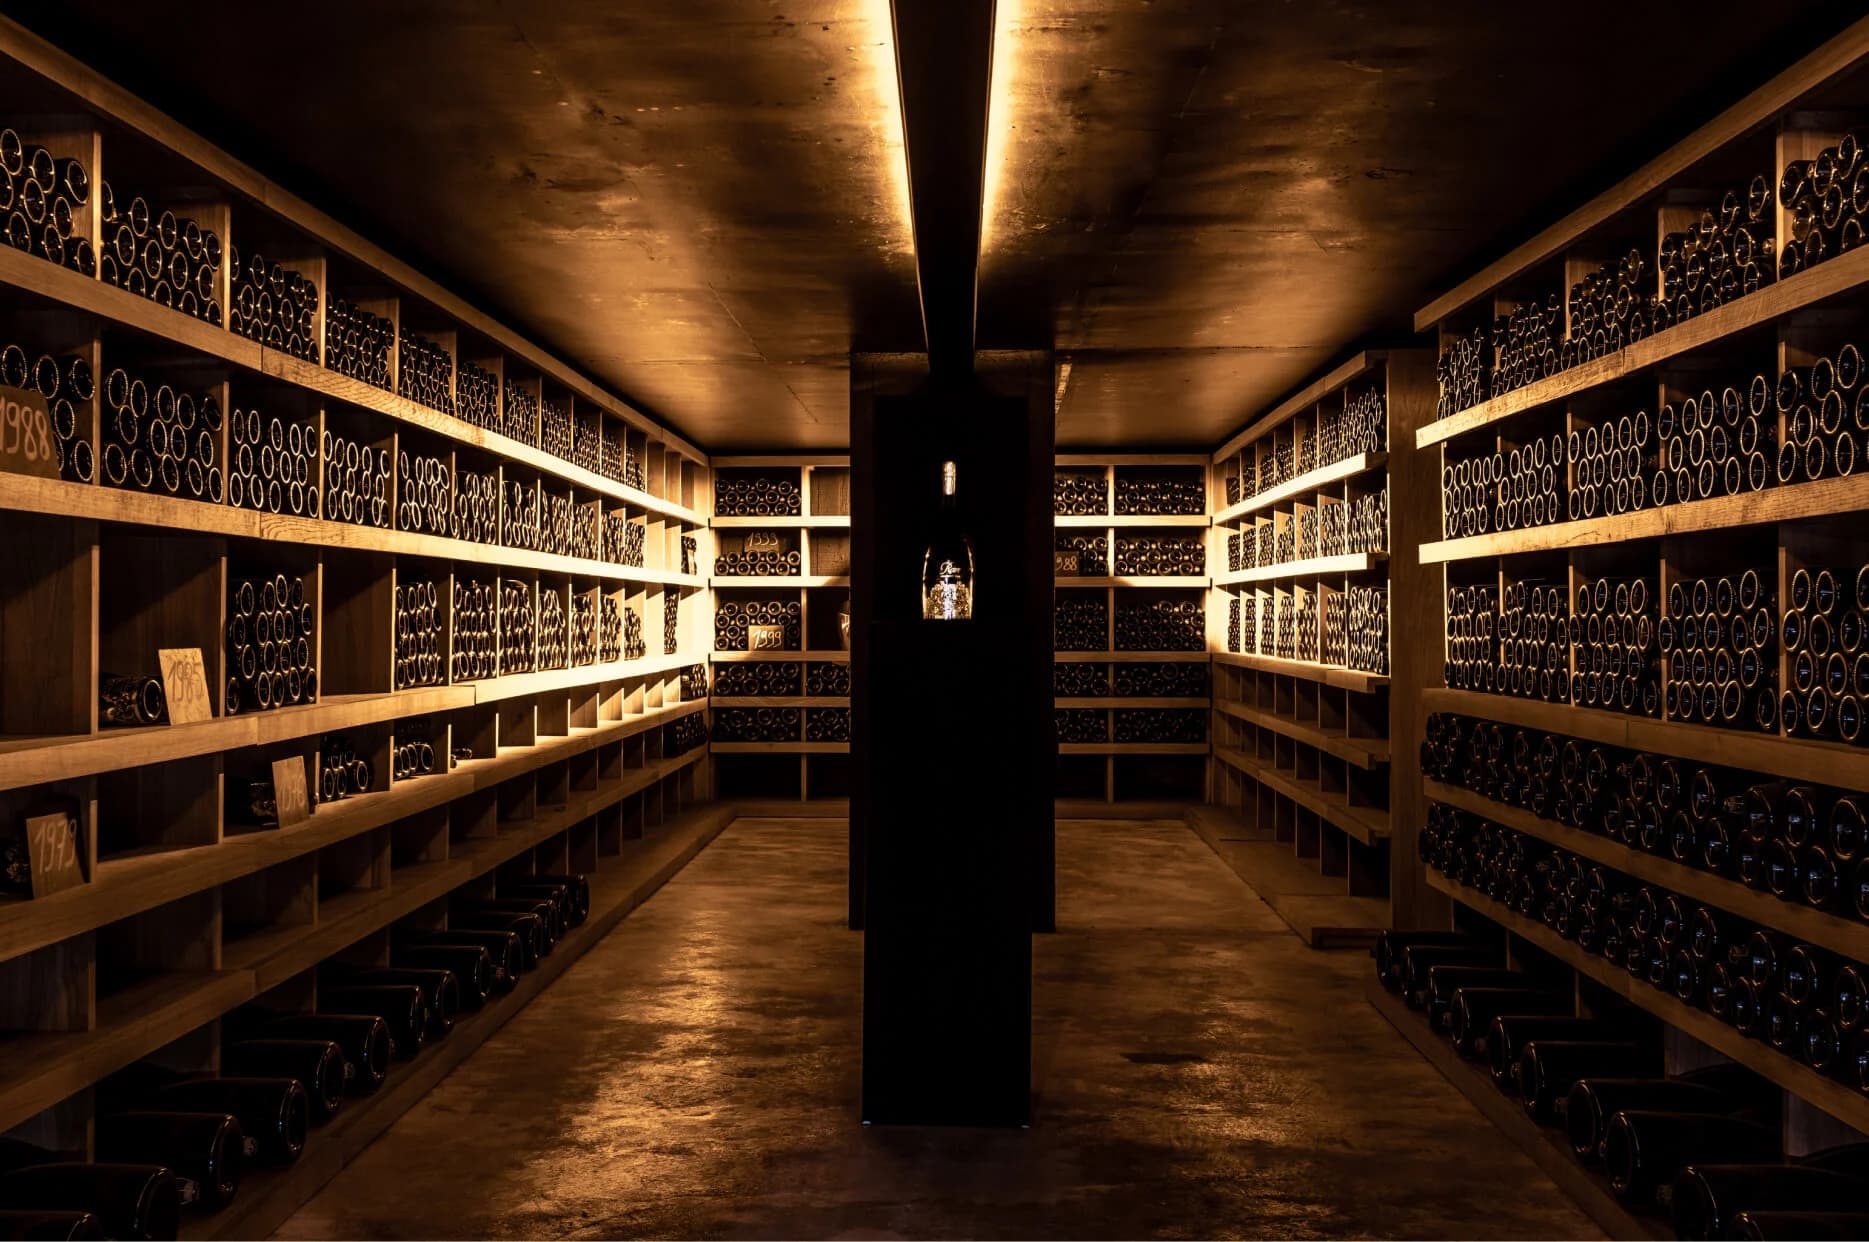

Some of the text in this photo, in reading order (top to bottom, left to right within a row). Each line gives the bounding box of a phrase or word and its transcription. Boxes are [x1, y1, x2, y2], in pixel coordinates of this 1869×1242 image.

[0, 396, 50, 462] 1988
[1055, 554, 1078, 571] 988
[753, 629, 782, 649] 1999
[34, 818, 78, 875] 1979
